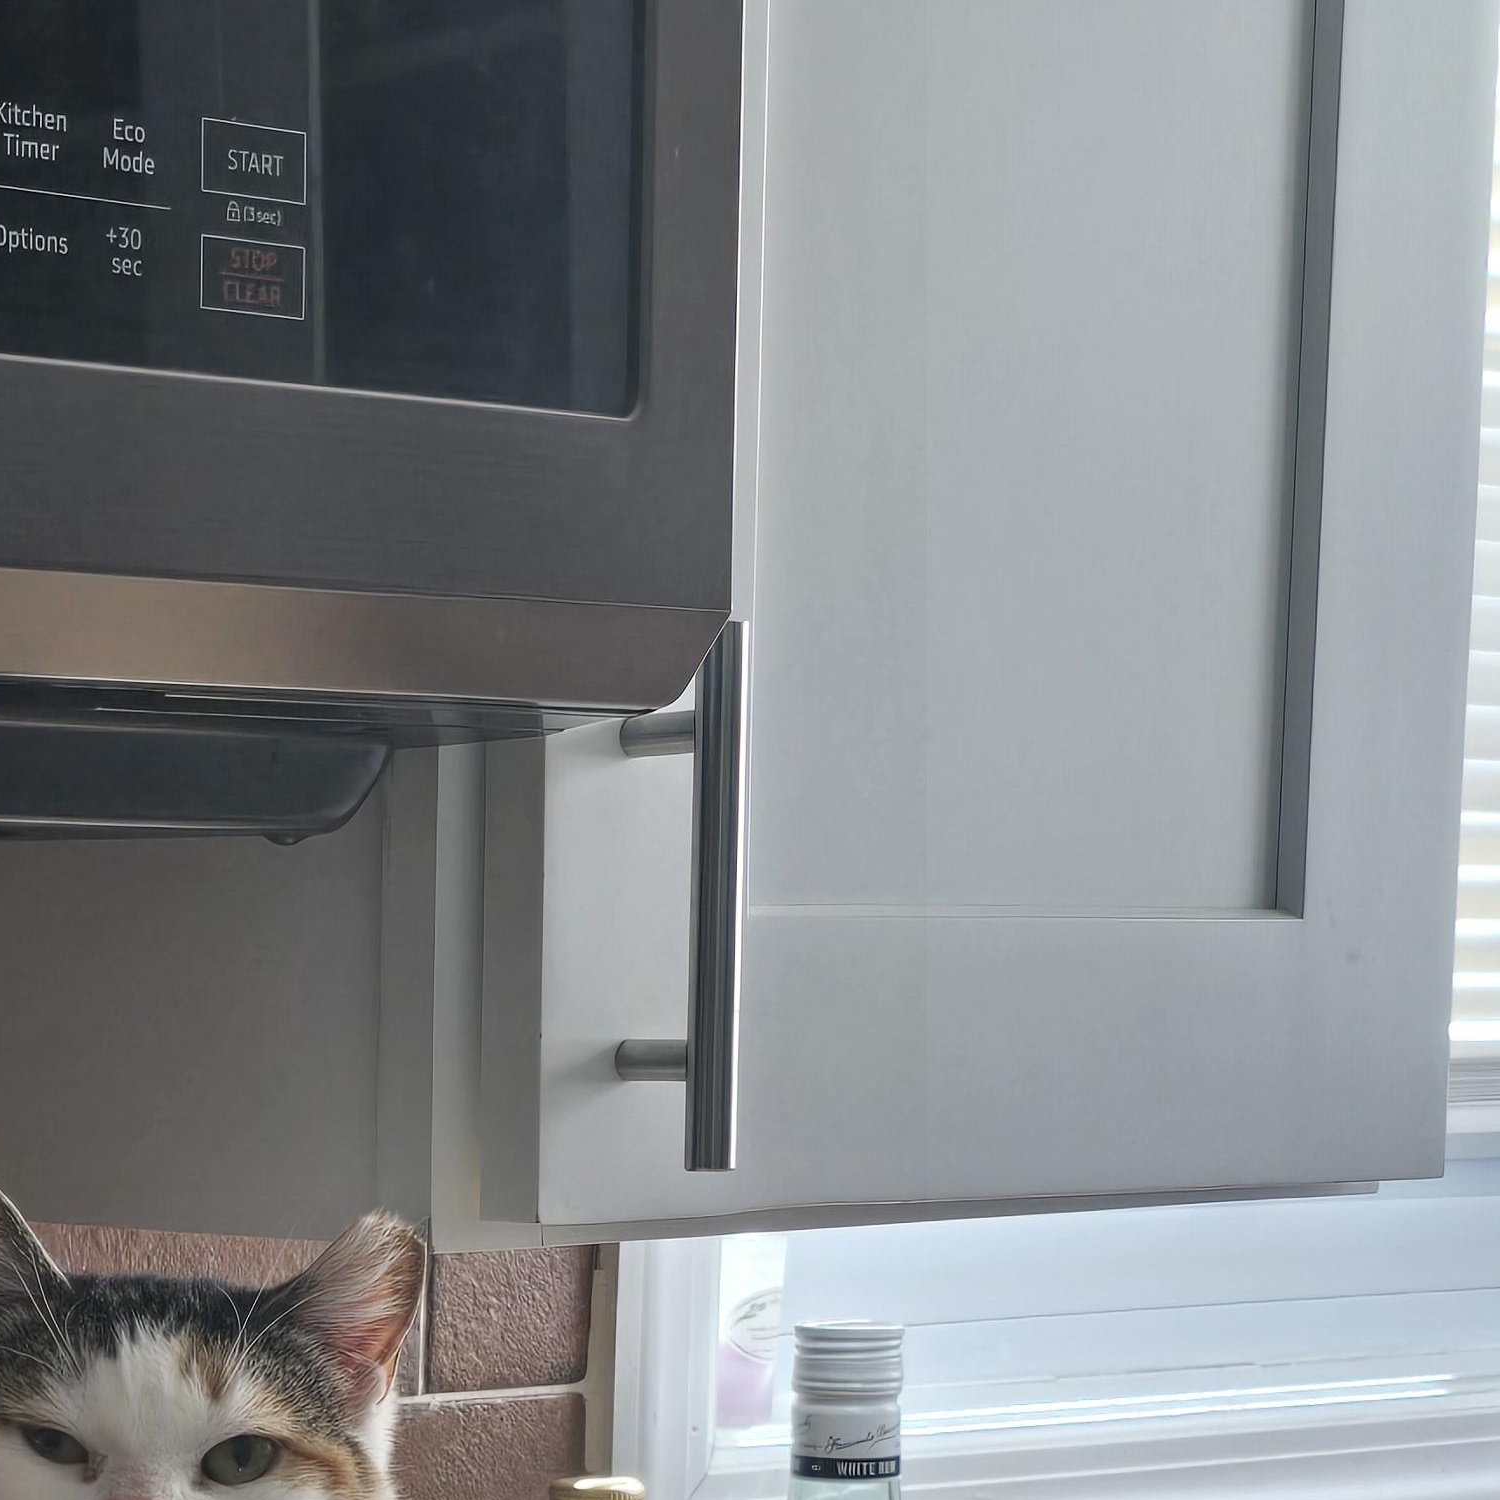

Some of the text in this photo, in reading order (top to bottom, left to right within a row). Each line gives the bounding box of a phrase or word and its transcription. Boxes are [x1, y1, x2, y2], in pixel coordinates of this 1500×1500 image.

[112, 117, 147, 144] Eco
[2, 132, 61, 163] Timer
[102, 146, 156, 176] Mode
[227, 148, 285, 178] START
[105, 226, 143, 252] +30
[111, 257, 143, 277] sec
[230, 246, 278, 272] STOP
[222, 279, 282, 308] CLEAR
[836, 1460, 876, 1477] WHITE
